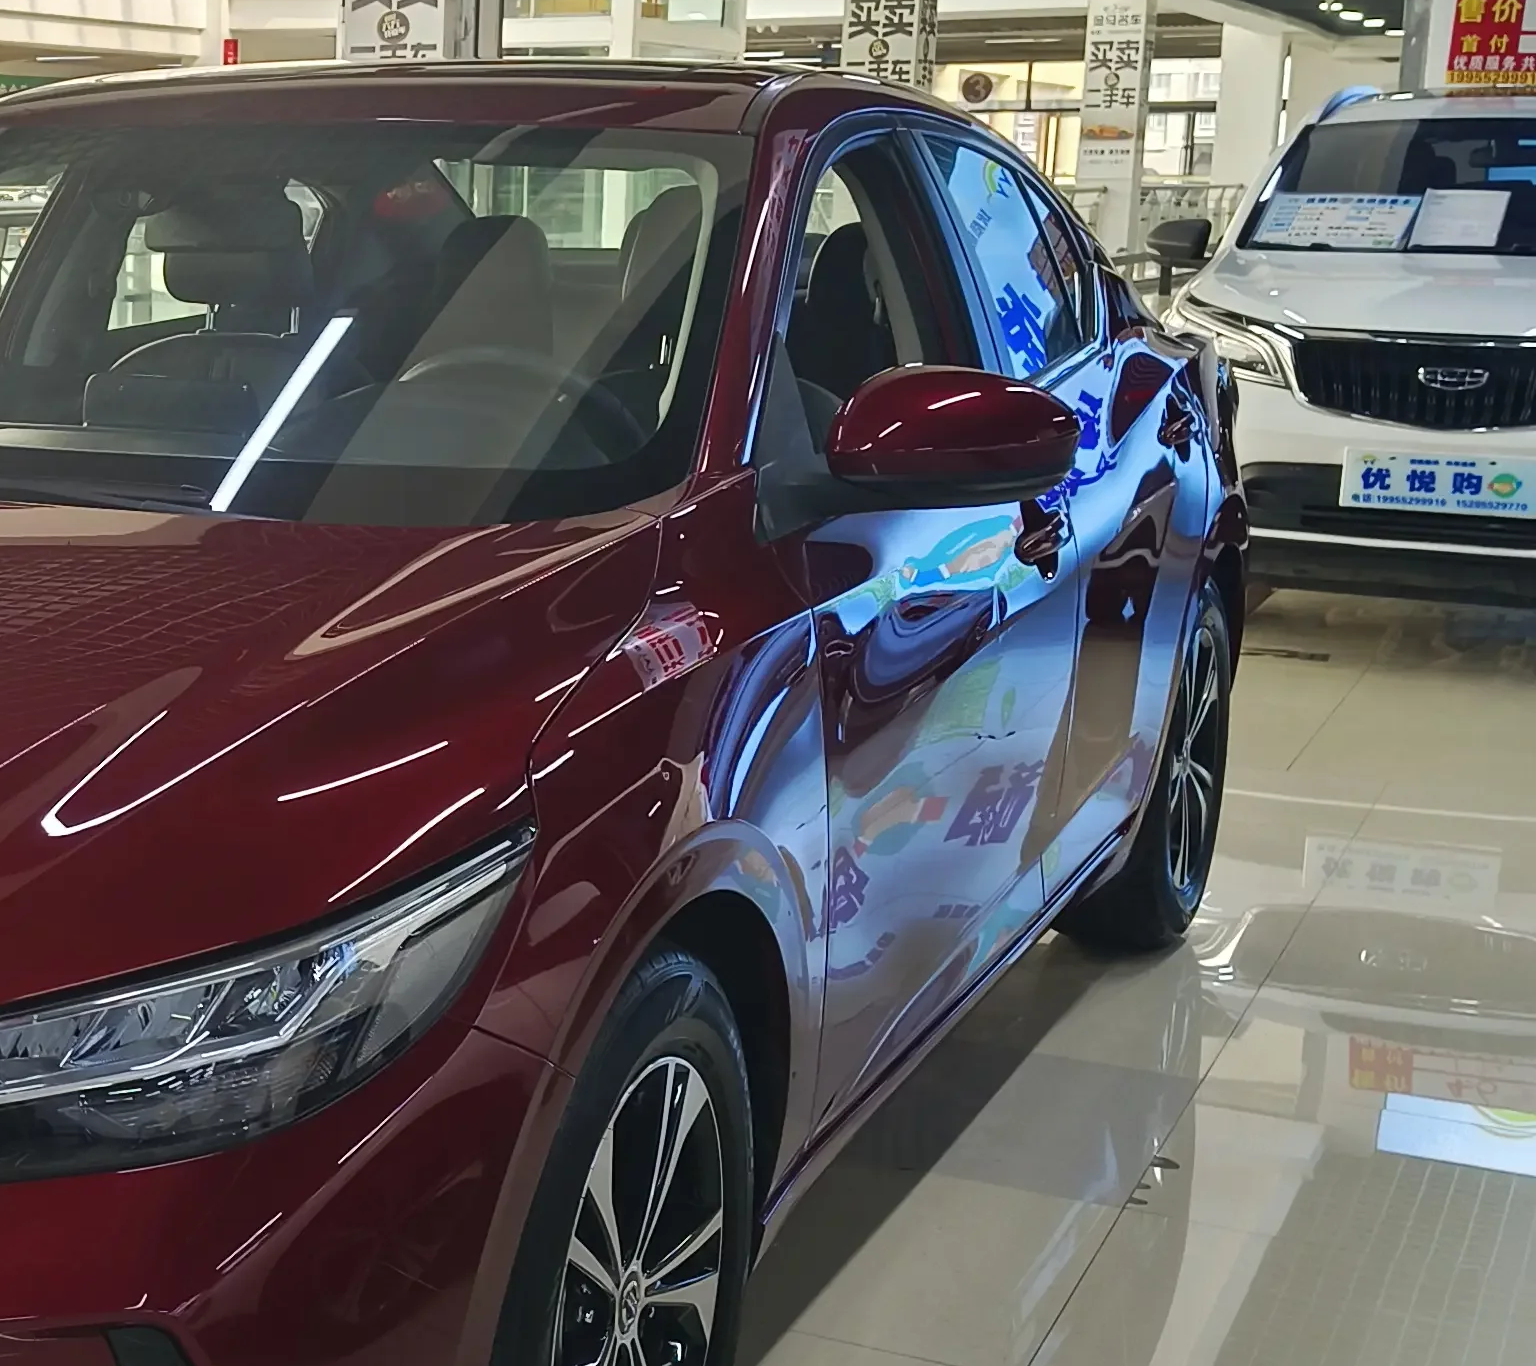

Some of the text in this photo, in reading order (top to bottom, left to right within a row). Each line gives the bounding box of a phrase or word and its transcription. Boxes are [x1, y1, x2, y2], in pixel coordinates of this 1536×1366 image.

[1460, 34, 1509, 53] 首付
[1089, 40, 1140, 72] 买卖
[1085, 87, 1136, 108] 二手车
[1361, 467, 1483, 495] 优悦购
